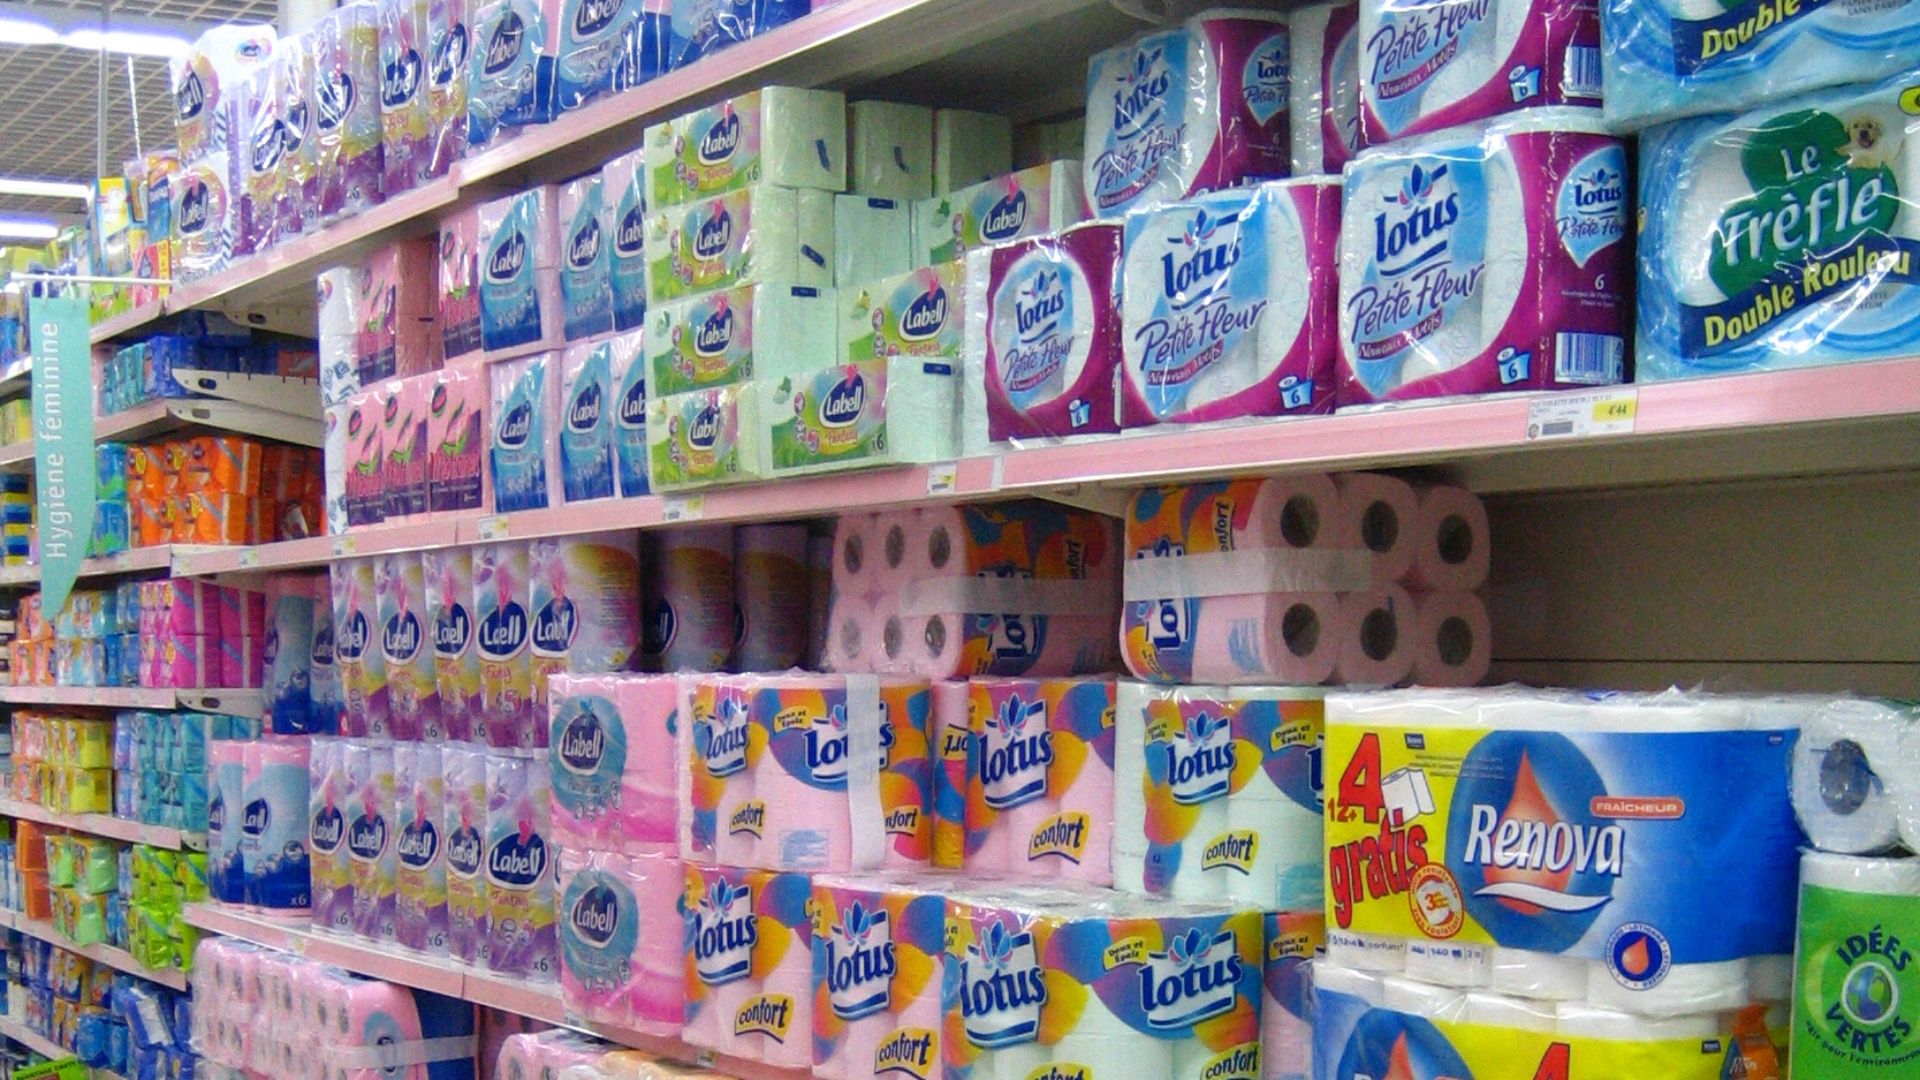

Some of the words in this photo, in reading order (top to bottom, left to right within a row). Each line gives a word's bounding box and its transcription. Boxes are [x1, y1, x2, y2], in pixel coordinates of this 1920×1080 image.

[1367, 16, 1429, 85] Petite
[1113, 71, 1169, 131] lotus
[705, 121, 738, 155] Labell
[1780, 145, 1821, 181] Le
[1573, 182, 1623, 206] lotus
[987, 202, 1024, 233] Labell
[1374, 191, 1459, 262] lotus
[1161, 234, 1241, 299] lotus
[1594, 273, 1606, 291] 6
[906, 298, 944, 330] Labell
[1015, 289, 1065, 335] lotus
[1346, 281, 1412, 344] Petite
[1411, 260, 1486, 311] Fleur
[1704, 284, 1796, 347] Double
[1134, 316, 1197, 371] Petite
[1194, 295, 1268, 342] Fleur
[36, 322, 63, 442] féminine
[1507, 364, 1519, 379] 6
[826, 384, 862, 415] Labell
[1074, 411, 1083, 425] 6
[1291, 391, 1301, 405] 6
[42, 453, 73, 560] Hygiène
[565, 728, 602, 759] Labell
[705, 722, 748, 760] lotus
[979, 730, 1054, 786] lotus
[1165, 742, 1236, 786] lotus
[1337, 732, 1385, 824] 4
[732, 803, 765, 829] confort
[1033, 816, 1085, 848] confort
[1205, 833, 1254, 862] confort
[1463, 803, 1624, 877] Renova
[492, 845, 540, 877] Labell
[1329, 814, 1429, 930] gratis
[576, 902, 615, 932] Labell
[694, 913, 758, 961] lotus
[532, 958, 549, 973] x6
[825, 941, 896, 993] lotus
[1836, 924, 1913, 972] IDÉES
[959, 960, 1046, 1018] lotus
[1138, 954, 1242, 1011] lotus
[738, 997, 788, 1029] confort
[1825, 1001, 1911, 1053] VERTES
[878, 1031, 931, 1066] confort
[1204, 1047, 1259, 1080] confort
